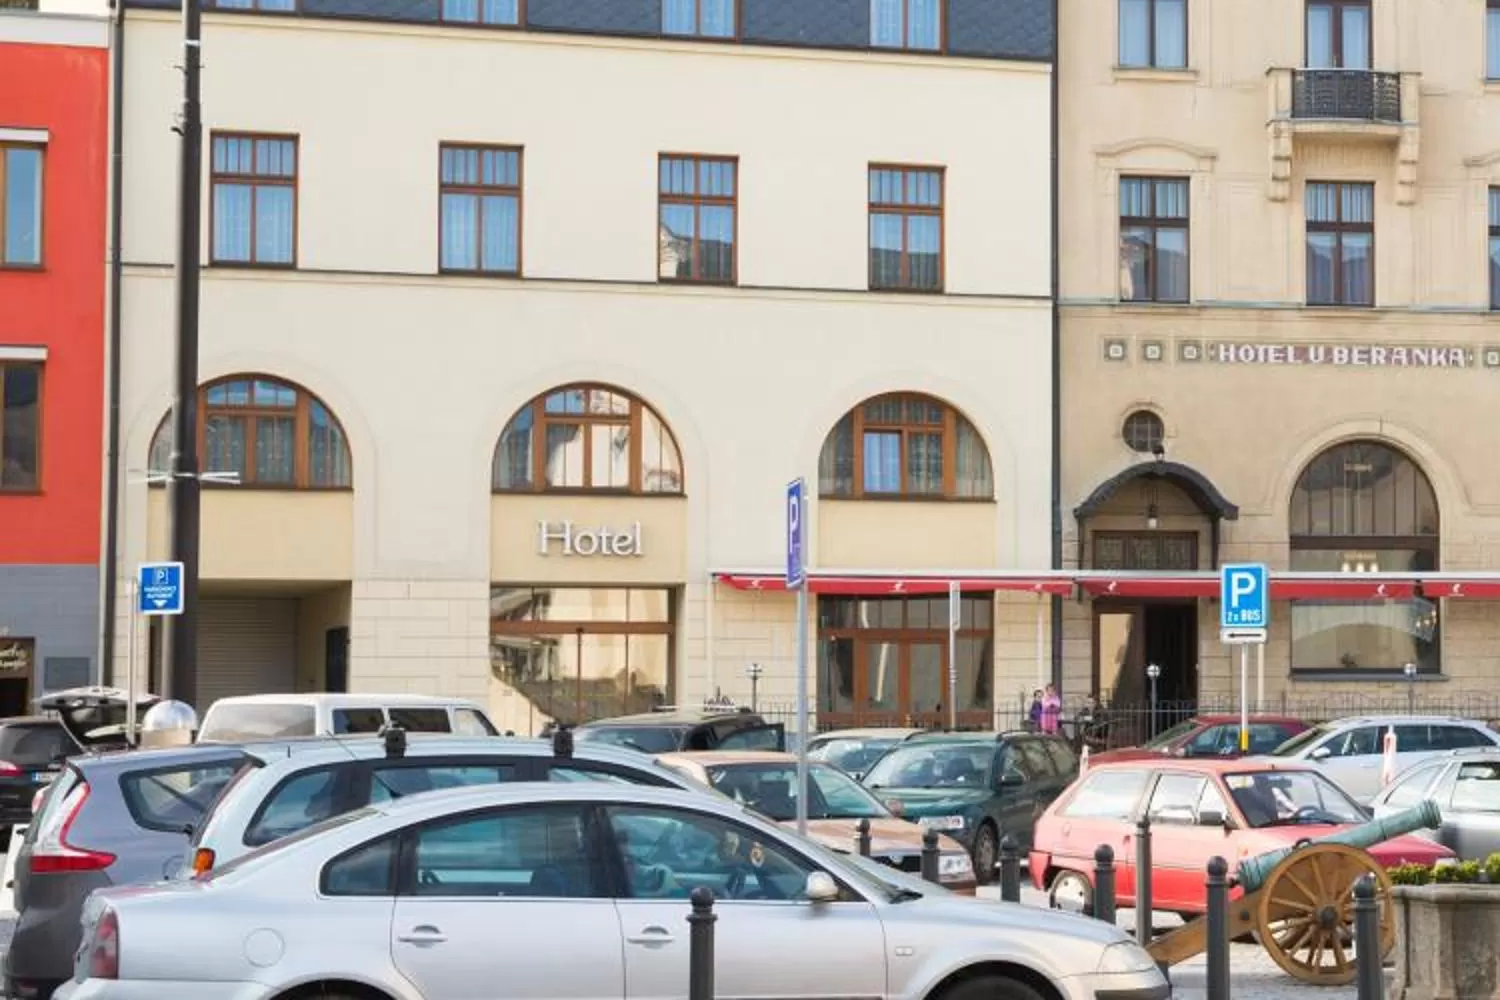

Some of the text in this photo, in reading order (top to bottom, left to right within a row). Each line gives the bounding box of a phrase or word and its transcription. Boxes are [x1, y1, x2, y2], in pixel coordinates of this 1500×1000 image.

[1219, 343, 1303, 363] HOTEL
[1309, 344, 1325, 364] U
[537, 519, 643, 556] Hotel
[1231, 571, 1257, 608] P
